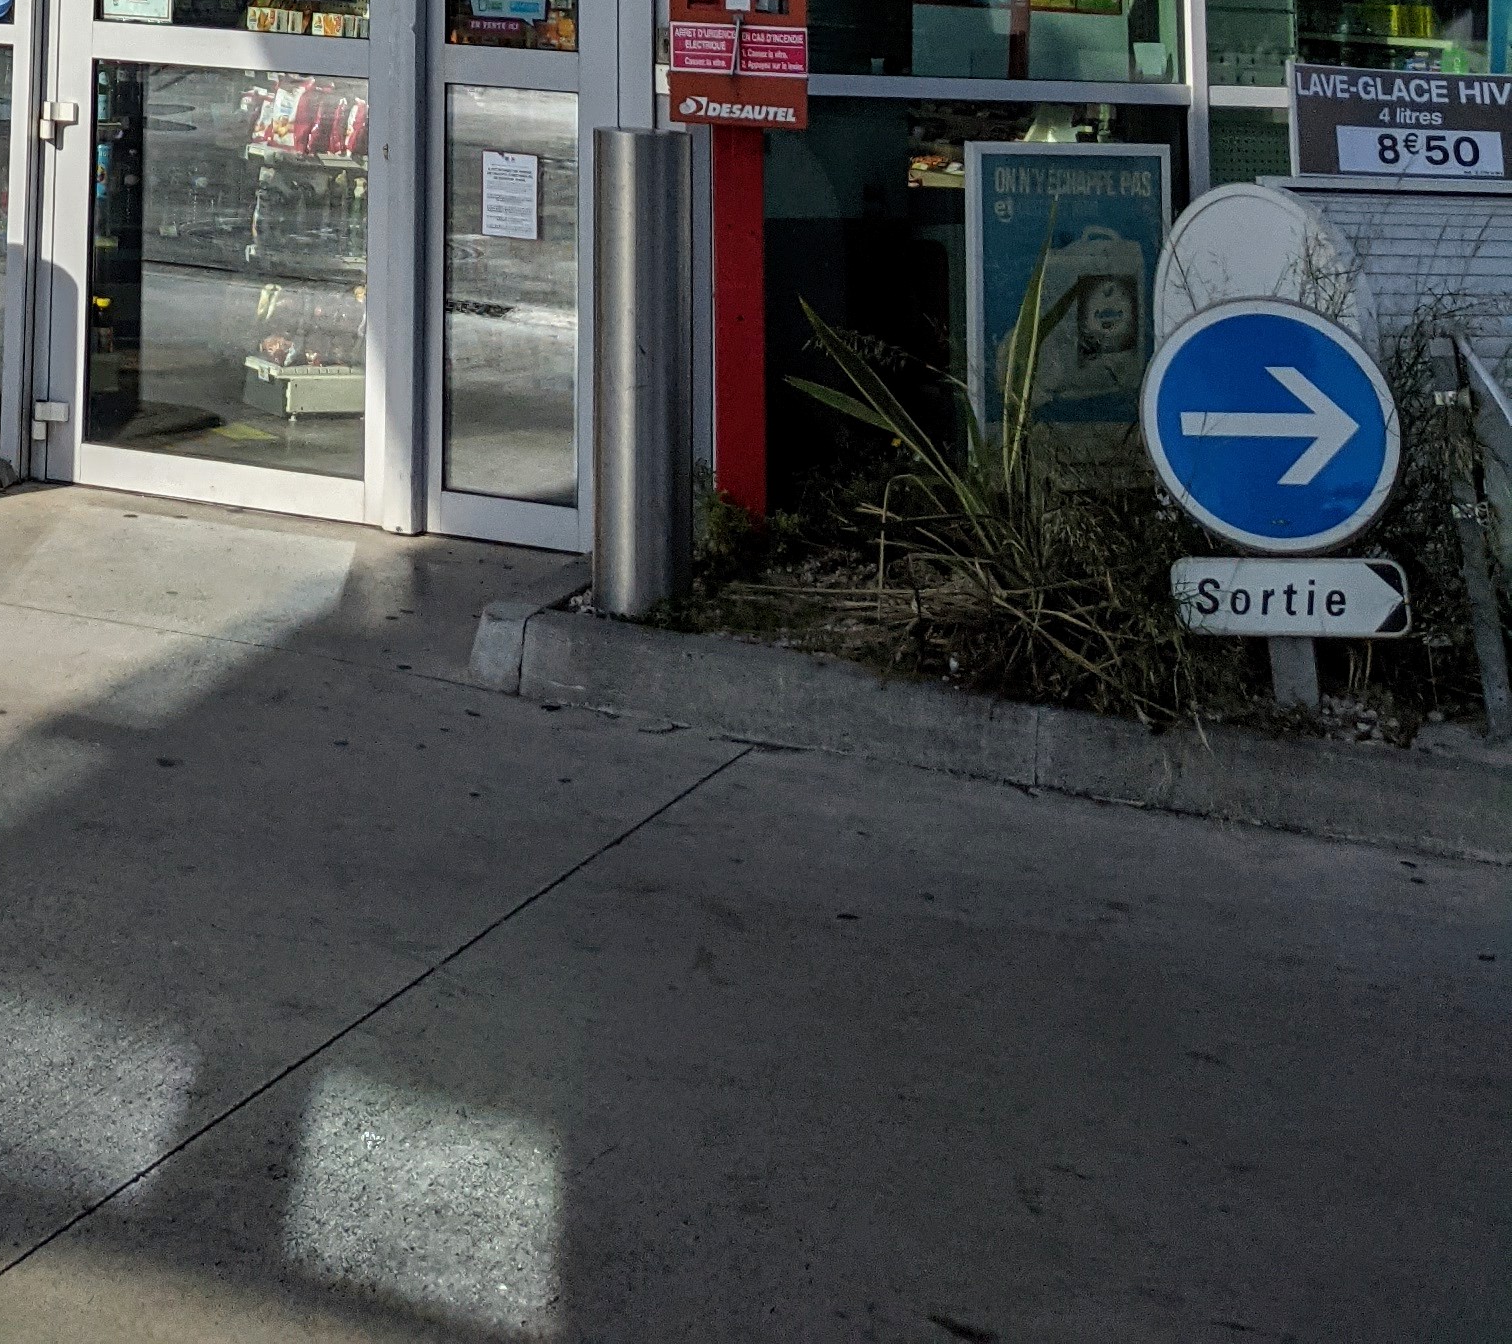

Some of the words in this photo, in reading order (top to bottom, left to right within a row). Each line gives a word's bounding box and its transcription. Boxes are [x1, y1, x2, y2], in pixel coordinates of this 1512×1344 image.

[1296, 72, 1449, 104] LAVE-GLACE
[707, 103, 796, 122] DESAUTEL
[1379, 108, 1391, 123] 4
[1396, 108, 1443, 125] litres
[1196, 577, 1347, 617] Sortie
